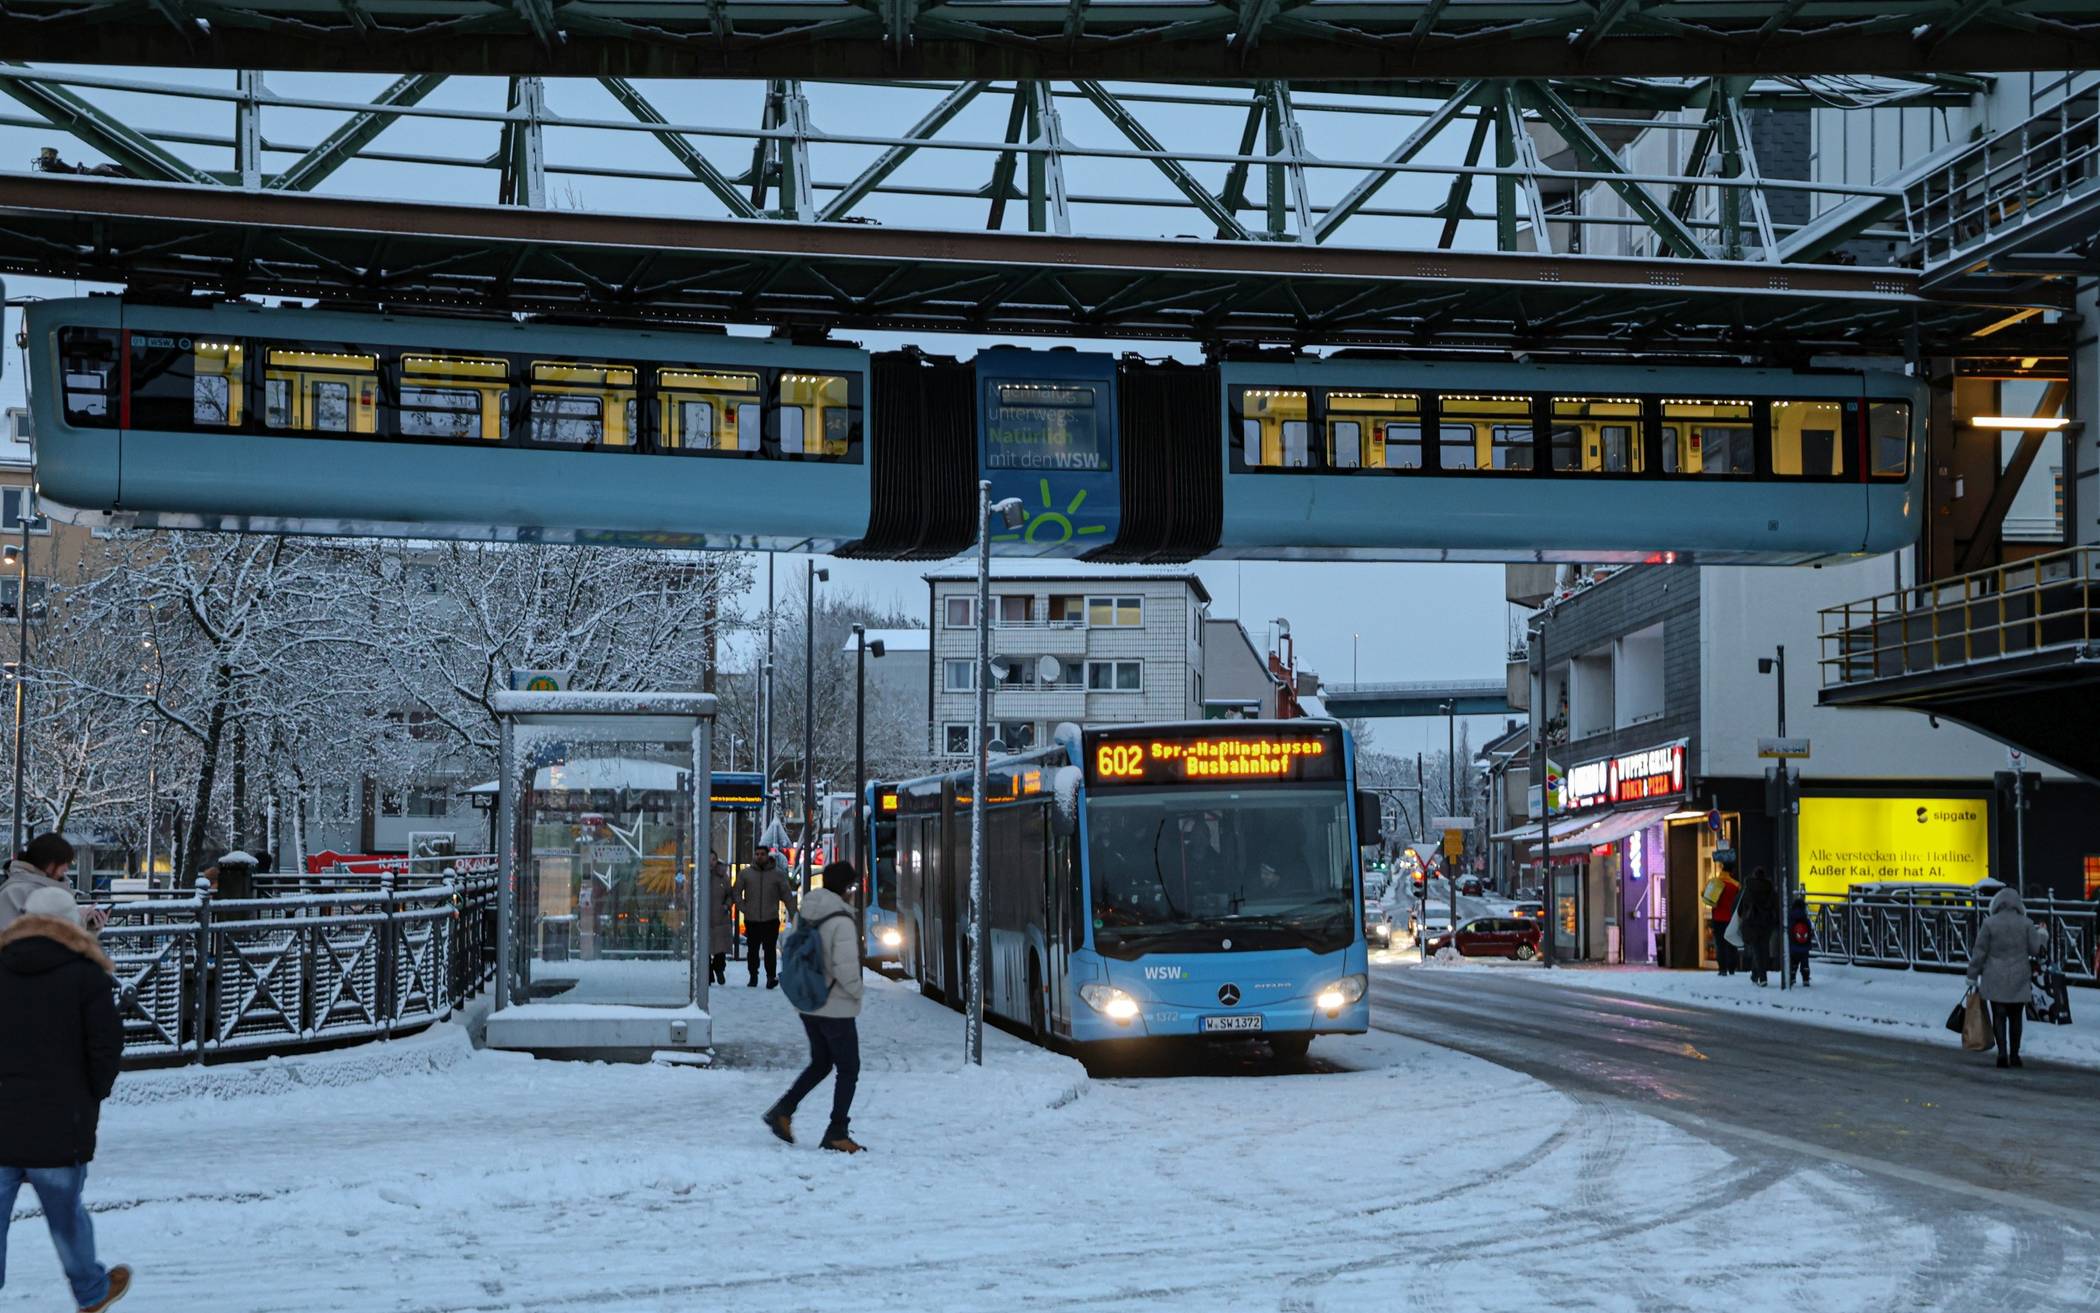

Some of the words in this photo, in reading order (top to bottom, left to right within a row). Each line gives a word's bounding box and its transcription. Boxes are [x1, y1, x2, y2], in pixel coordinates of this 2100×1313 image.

[989, 407, 1079, 426] unterwegs.
[990, 427, 1073, 444] Natürlich
[990, 450, 1016, 466] mit
[1021, 449, 1052, 467] den
[1151, 740, 1322, 758] Spr.-Haßlinghausen
[1098, 745, 1143, 775] 602
[1186, 755, 1289, 775] Busbahnhof
[1649, 747, 1673, 776] GRILL
[1648, 774, 1670, 797] PIZZA
[1934, 811, 1977, 822] sipgate
[1809, 849, 1831, 861] Alle
[1835, 849, 1896, 862] verstecken
[1900, 850, 1922, 862] ihre
[1927, 850, 1974, 863] Hotline.
[1809, 865, 1846, 876] Außer
[1850, 866, 1874, 877] Kai,
[1879, 866, 1899, 877] der
[1904, 866, 1923, 876] hat
[1156, 1011, 1178, 1022] 1372
